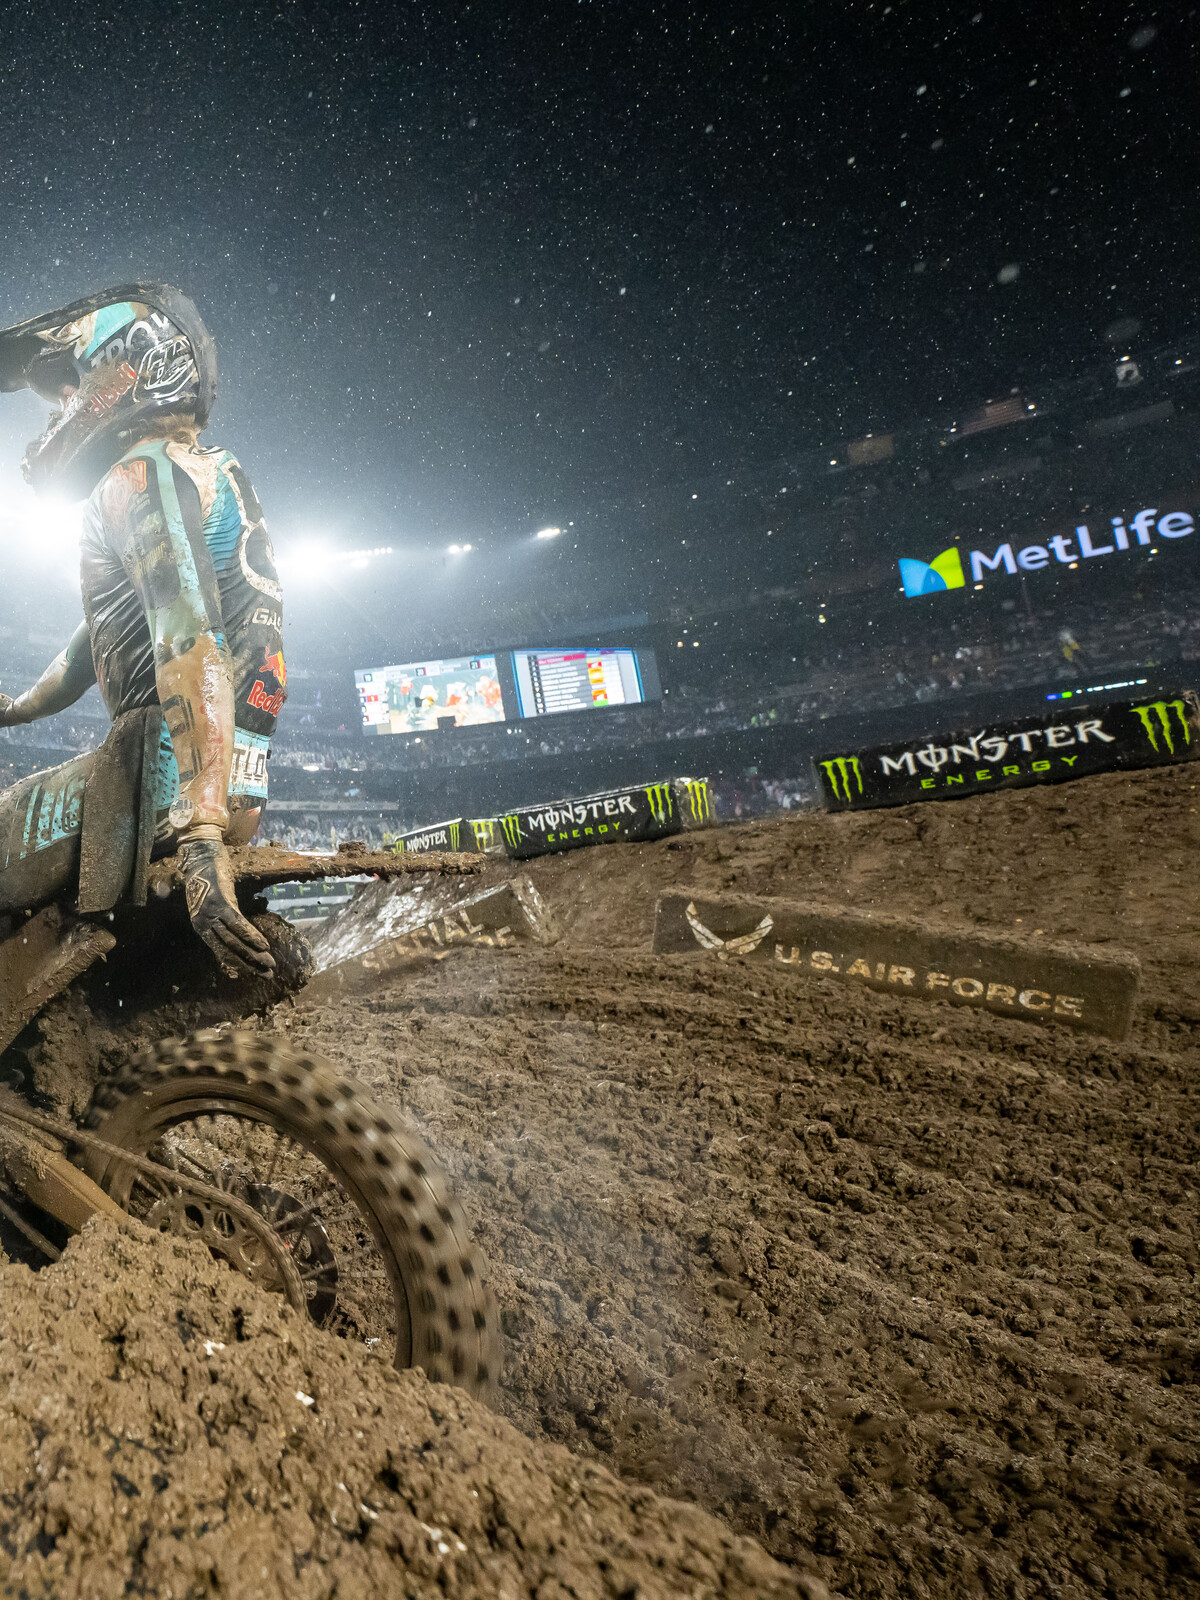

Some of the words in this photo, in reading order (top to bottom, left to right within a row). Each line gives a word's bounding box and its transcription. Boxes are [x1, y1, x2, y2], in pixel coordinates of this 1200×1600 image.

[968, 508, 1196, 583] MetLife
[879, 719, 1117, 777] MONSTER
[920, 755, 1079, 790] ENERGY
[527, 795, 638, 832] MONSTER
[547, 821, 622, 843] ENERGY
[406, 830, 448, 853] MONSTER
[846, 957, 916, 988] AIR
[924, 970, 1086, 1019] FORCE
